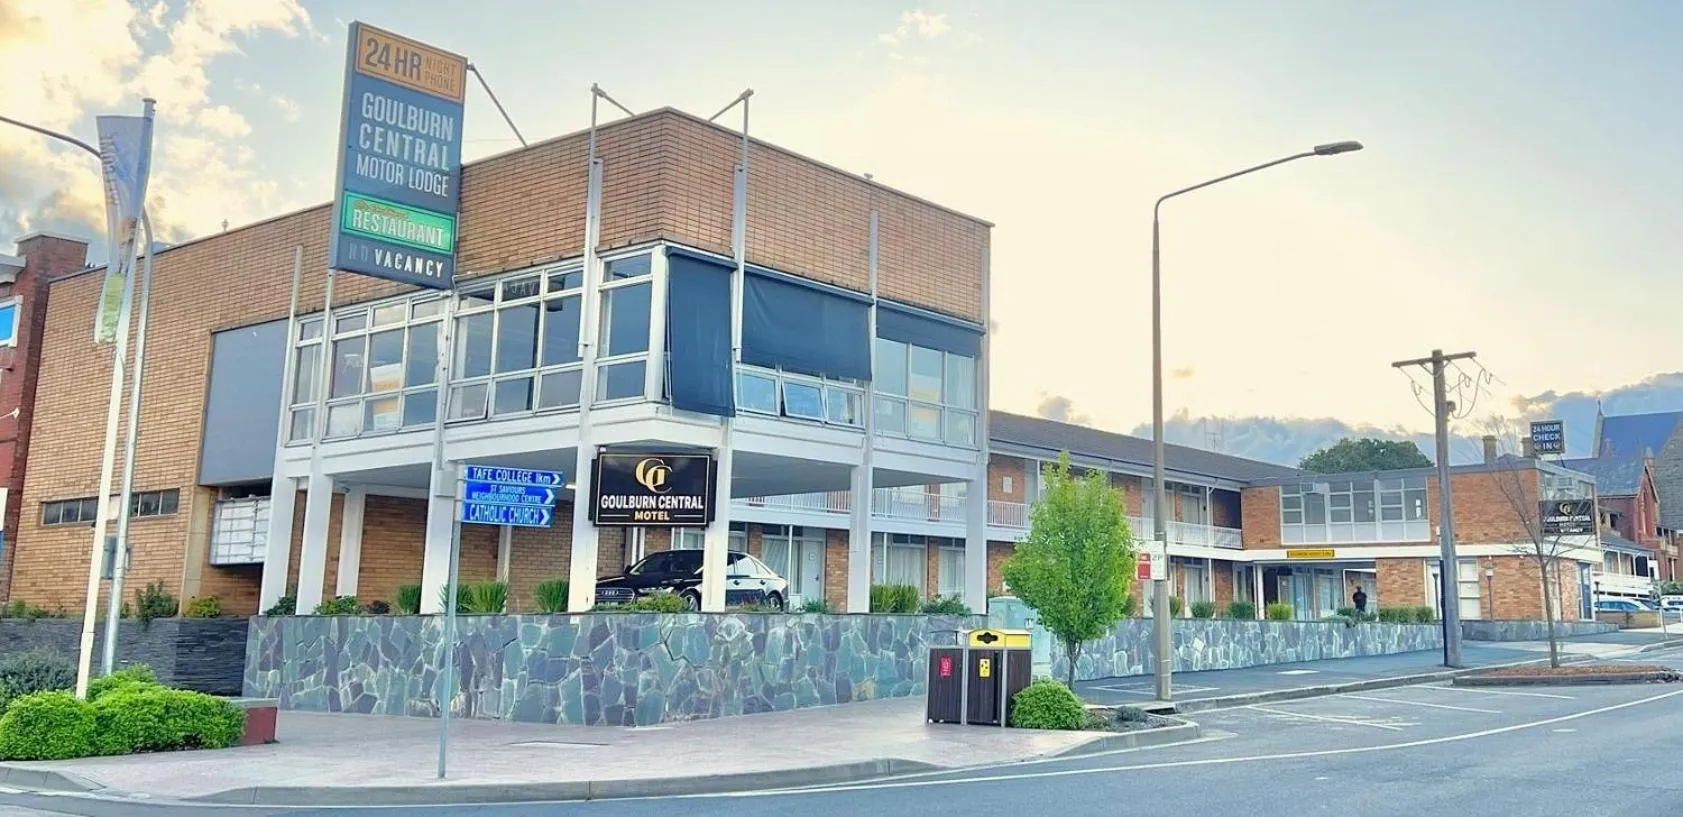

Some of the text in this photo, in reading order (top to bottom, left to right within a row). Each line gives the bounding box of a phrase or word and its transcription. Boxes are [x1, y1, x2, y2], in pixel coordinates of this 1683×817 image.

[364, 37, 422, 81] 24 HR
[425, 55, 457, 75] NIGHT
[425, 70, 457, 92] PHONE
[361, 92, 454, 141] GOULBURN
[359, 123, 450, 171] CENTRAL
[356, 154, 450, 197] MOTOR LODGE
[352, 209, 445, 246] RESTAURANT
[374, 248, 444, 278] VACANCY
[1533, 433, 1560, 441] CHECK
[473, 467, 493, 480] TAFE
[495, 470, 533, 484] COLLEGE
[601, 495, 704, 510] GOULBURN CENTRAL
[469, 504, 540, 524] CATHOLIC CHURCH
[634, 510, 671, 521] MOTEL
